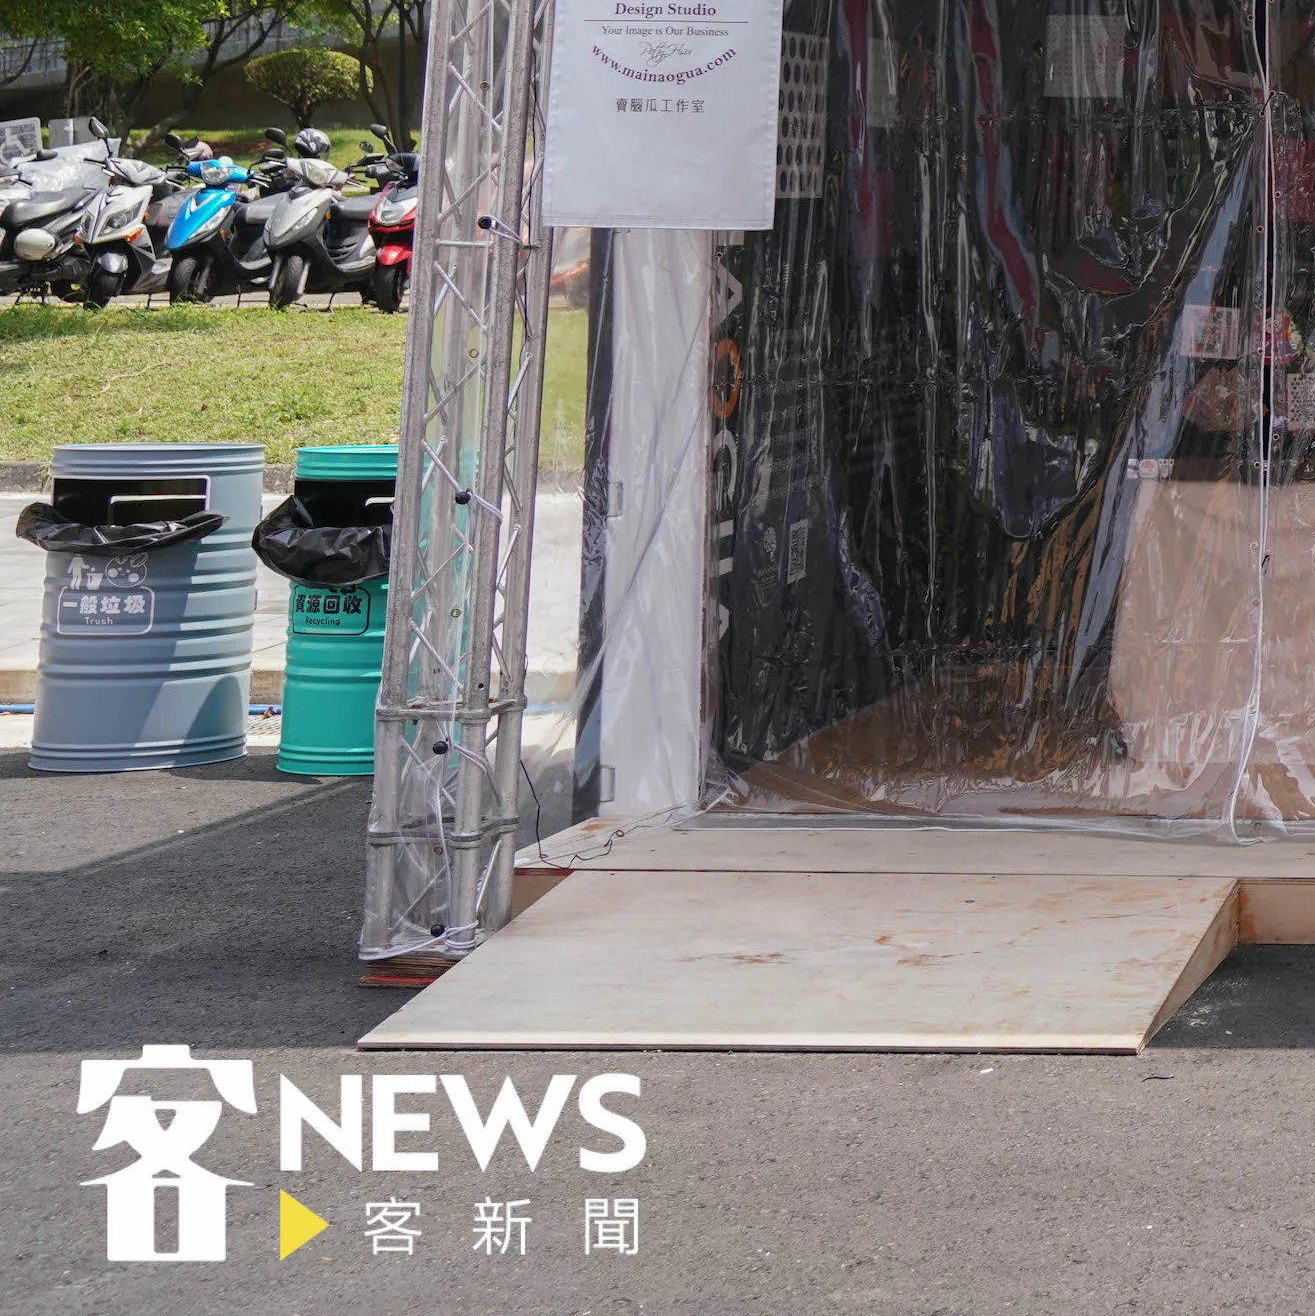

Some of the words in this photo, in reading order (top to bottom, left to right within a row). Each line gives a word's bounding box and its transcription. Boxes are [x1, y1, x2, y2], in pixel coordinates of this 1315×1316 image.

[615, 2, 663, 18] Design
[667, 3, 717, 16] Studio
[602, 25, 623, 35] Your
[626, 26, 653, 37] Image
[655, 26, 663, 35] is
[665, 26, 684, 35] Our
[686, 27, 729, 37] Business
[591, 44, 737, 86] www.mainaogua.com
[62, 595, 146, 615] 一般垃圾
[295, 593, 363, 615] 資源回收
[305, 615, 340, 626] Recycling
